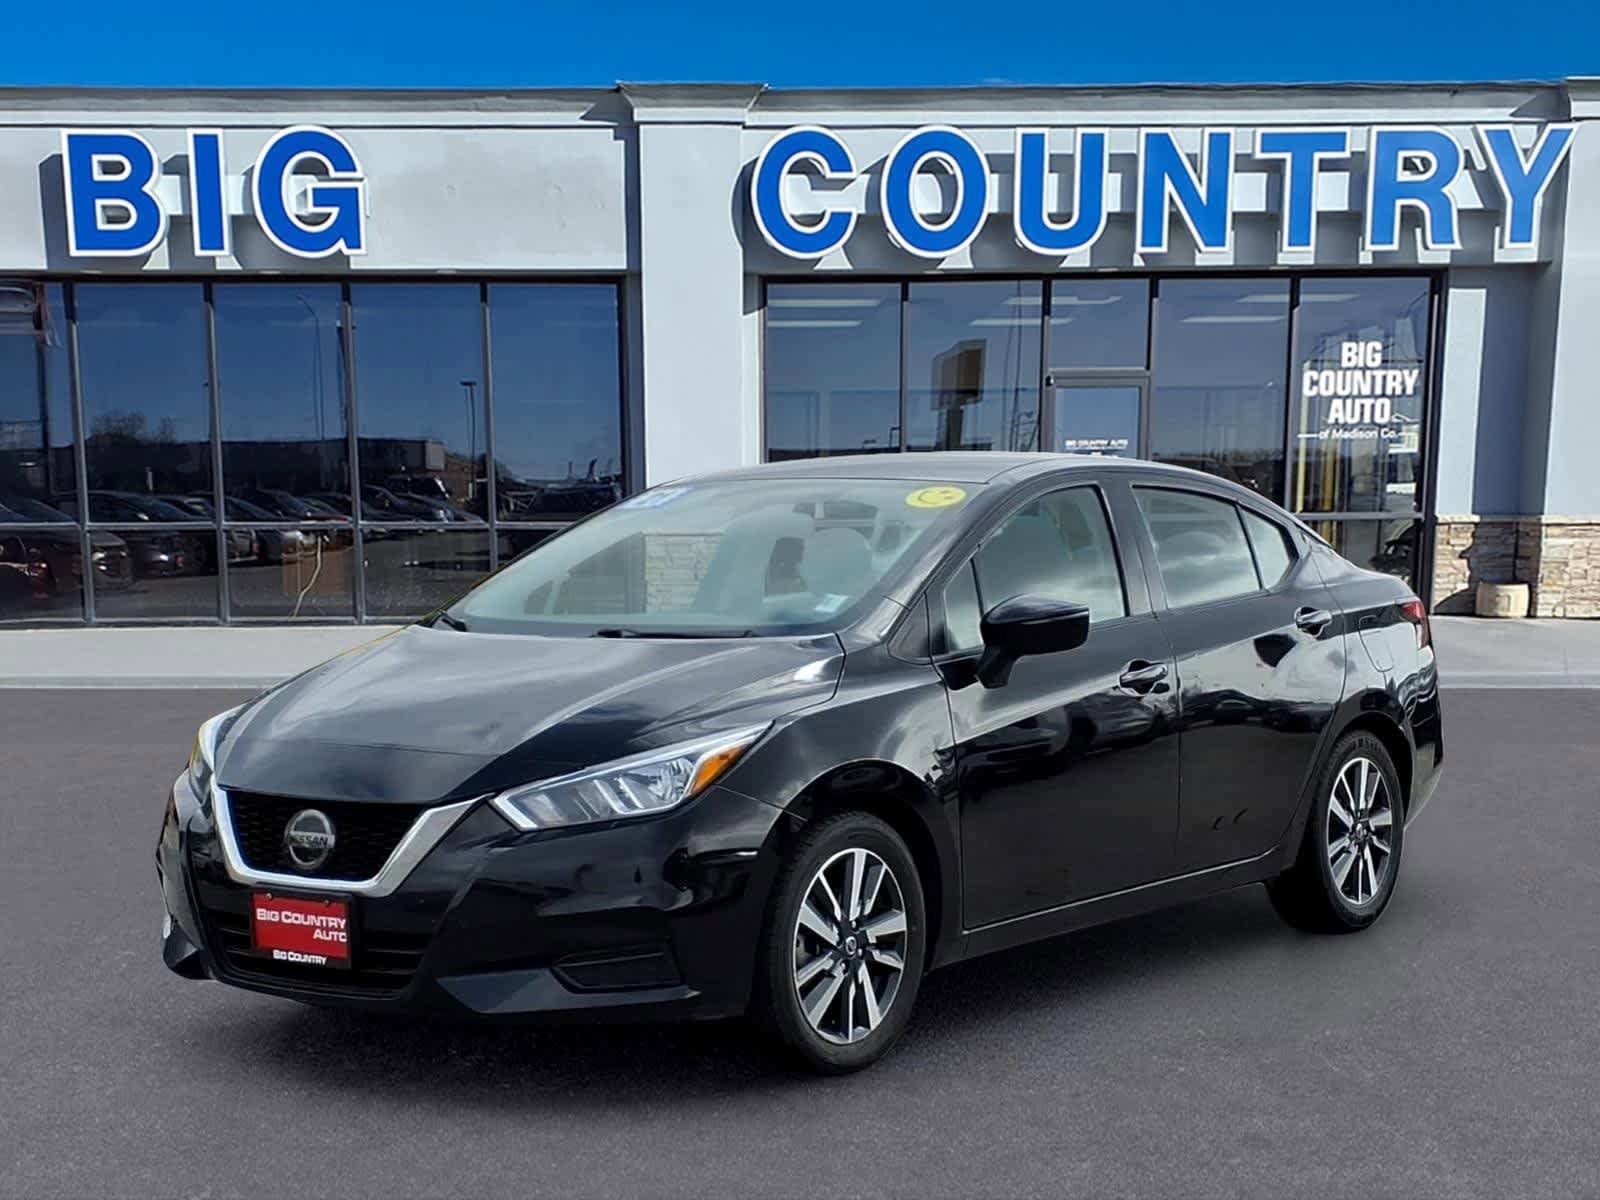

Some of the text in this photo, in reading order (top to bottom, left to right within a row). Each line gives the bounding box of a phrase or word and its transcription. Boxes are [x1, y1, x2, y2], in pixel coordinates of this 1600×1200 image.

[60, 123, 1578, 259] BIG COUNTRY
[1341, 341, 1383, 368] BIG
[1303, 369, 1419, 396] COUNTRY
[1329, 398, 1391, 424] AUTO
[1320, 427, 1399, 440] of Madison Co.
[256, 908, 347, 930] BIG COUNTRY
[313, 928, 348, 942] AUTO
[288, 951, 328, 965] COUNTRY
